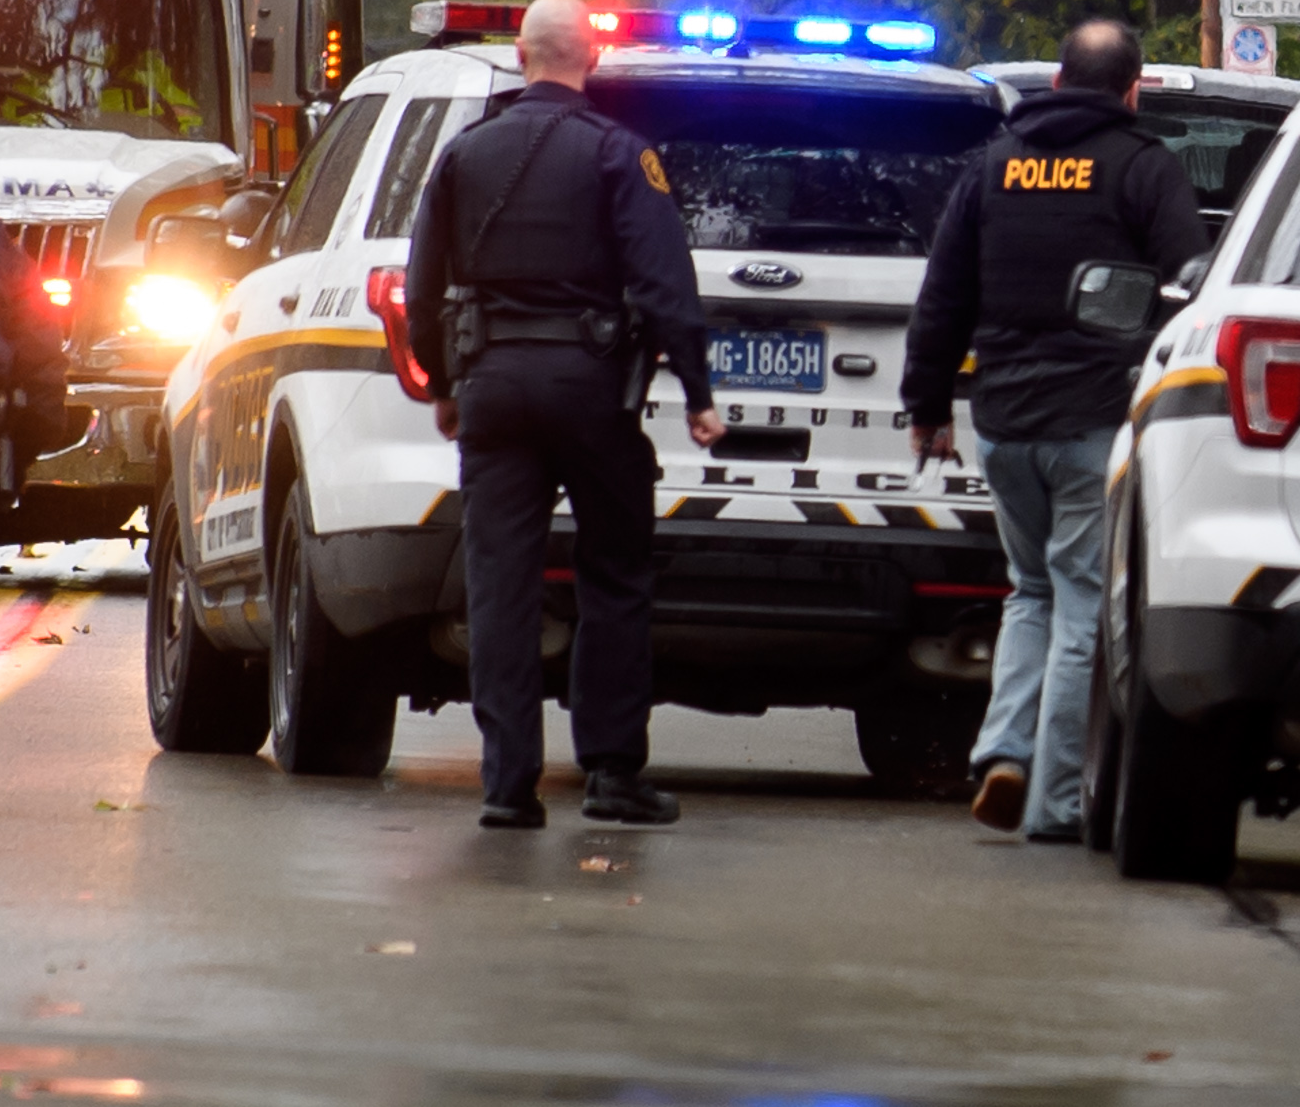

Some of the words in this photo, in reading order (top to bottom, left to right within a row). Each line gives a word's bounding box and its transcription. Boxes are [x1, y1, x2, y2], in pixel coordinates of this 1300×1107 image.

[1003, 157, 1094, 190] POLICE
[745, 262, 788, 284] Ford
[656, 465, 990, 495] LICE
